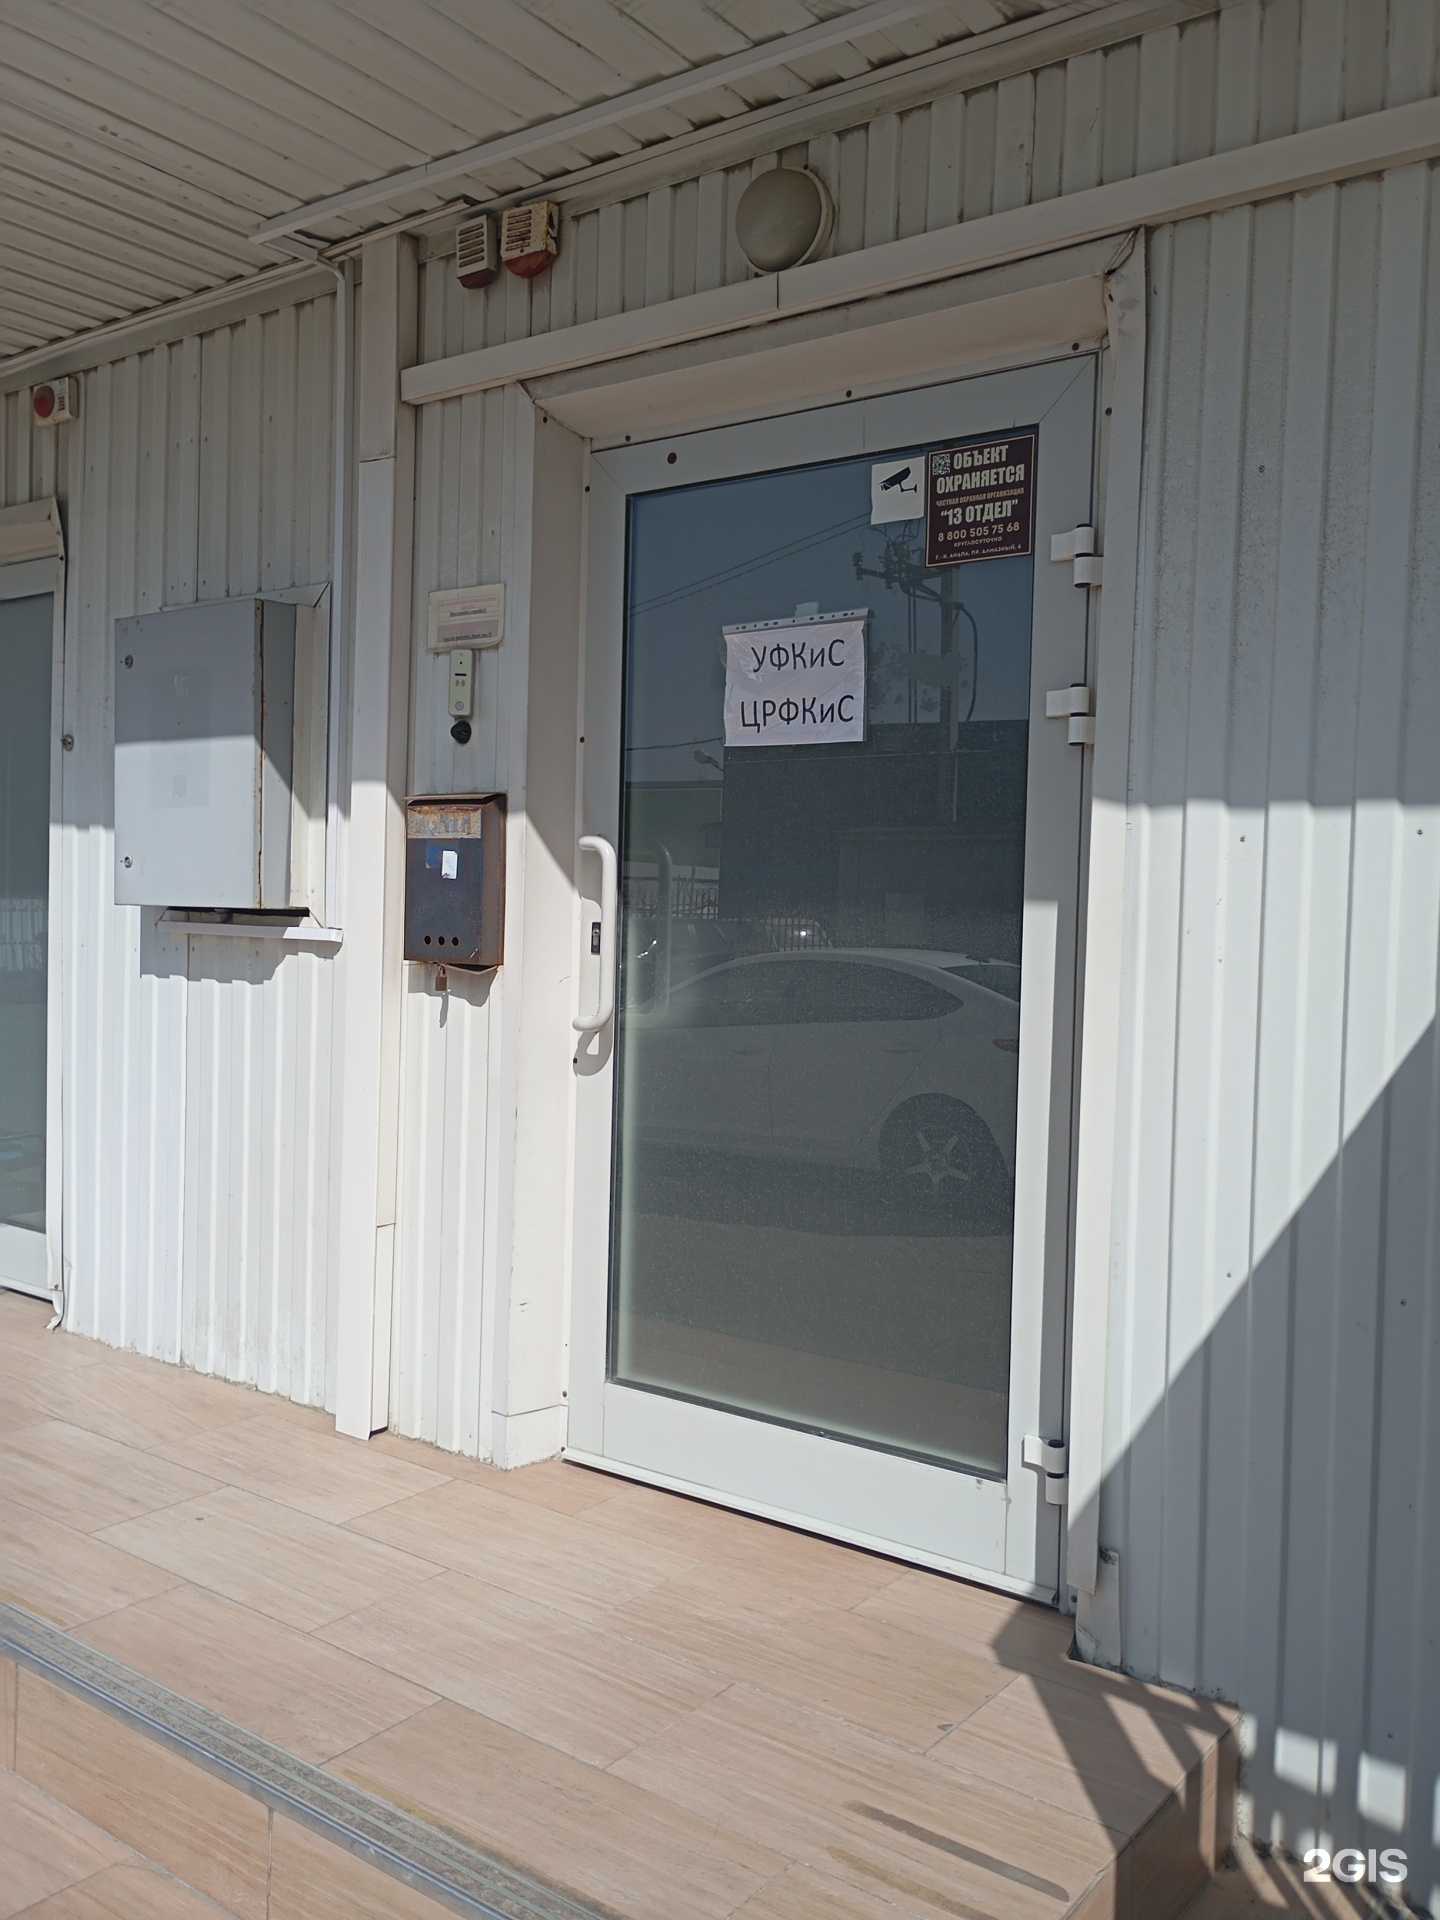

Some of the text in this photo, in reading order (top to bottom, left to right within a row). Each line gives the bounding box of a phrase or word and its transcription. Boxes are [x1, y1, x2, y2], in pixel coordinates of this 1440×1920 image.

[953, 445, 1009, 469] ОБЪЕКТ
[936, 463, 1025, 494] ОХРАНЯЕТСЯ
[938, 521, 1020, 542] 8 800 505 75 68
[751, 639, 845, 673] УФКиС
[740, 694, 855, 733] ЦРФКиС
